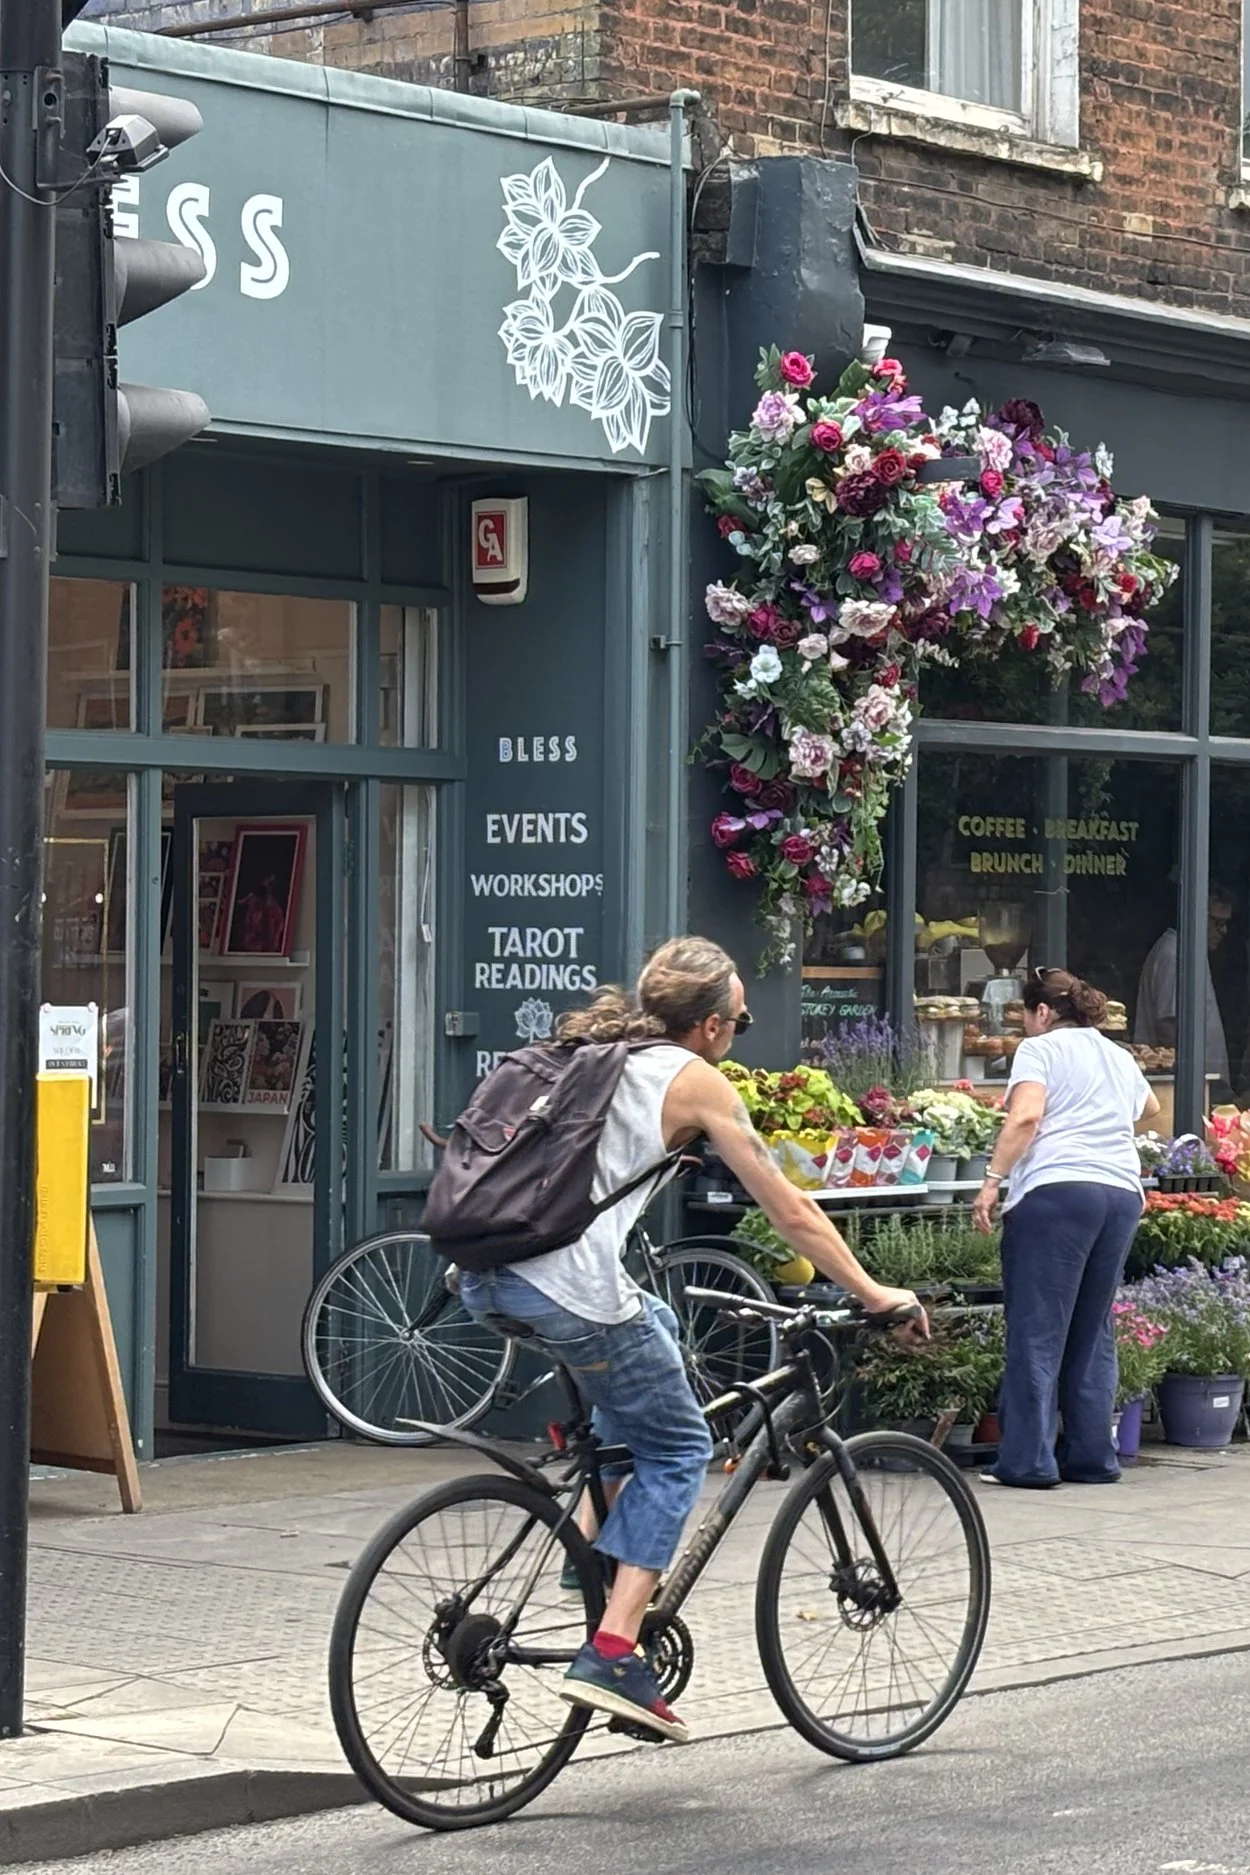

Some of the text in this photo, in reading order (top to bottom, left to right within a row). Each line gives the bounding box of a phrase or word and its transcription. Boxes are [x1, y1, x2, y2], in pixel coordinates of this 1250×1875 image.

[499, 735, 578, 763] BLESS
[486, 812, 589, 844] EVENTS
[958, 815, 1139, 842] COFFEE BREAKFAST
[970, 851, 1127, 877] BRUNCH DINNER
[470, 873, 604, 897] WORKSHOPS
[487, 926, 584, 958] TAROT
[475, 962, 598, 992] READINGS
[801, 1002, 836, 1017] STOKEY
[247, 1090, 290, 1105] JAPAN
